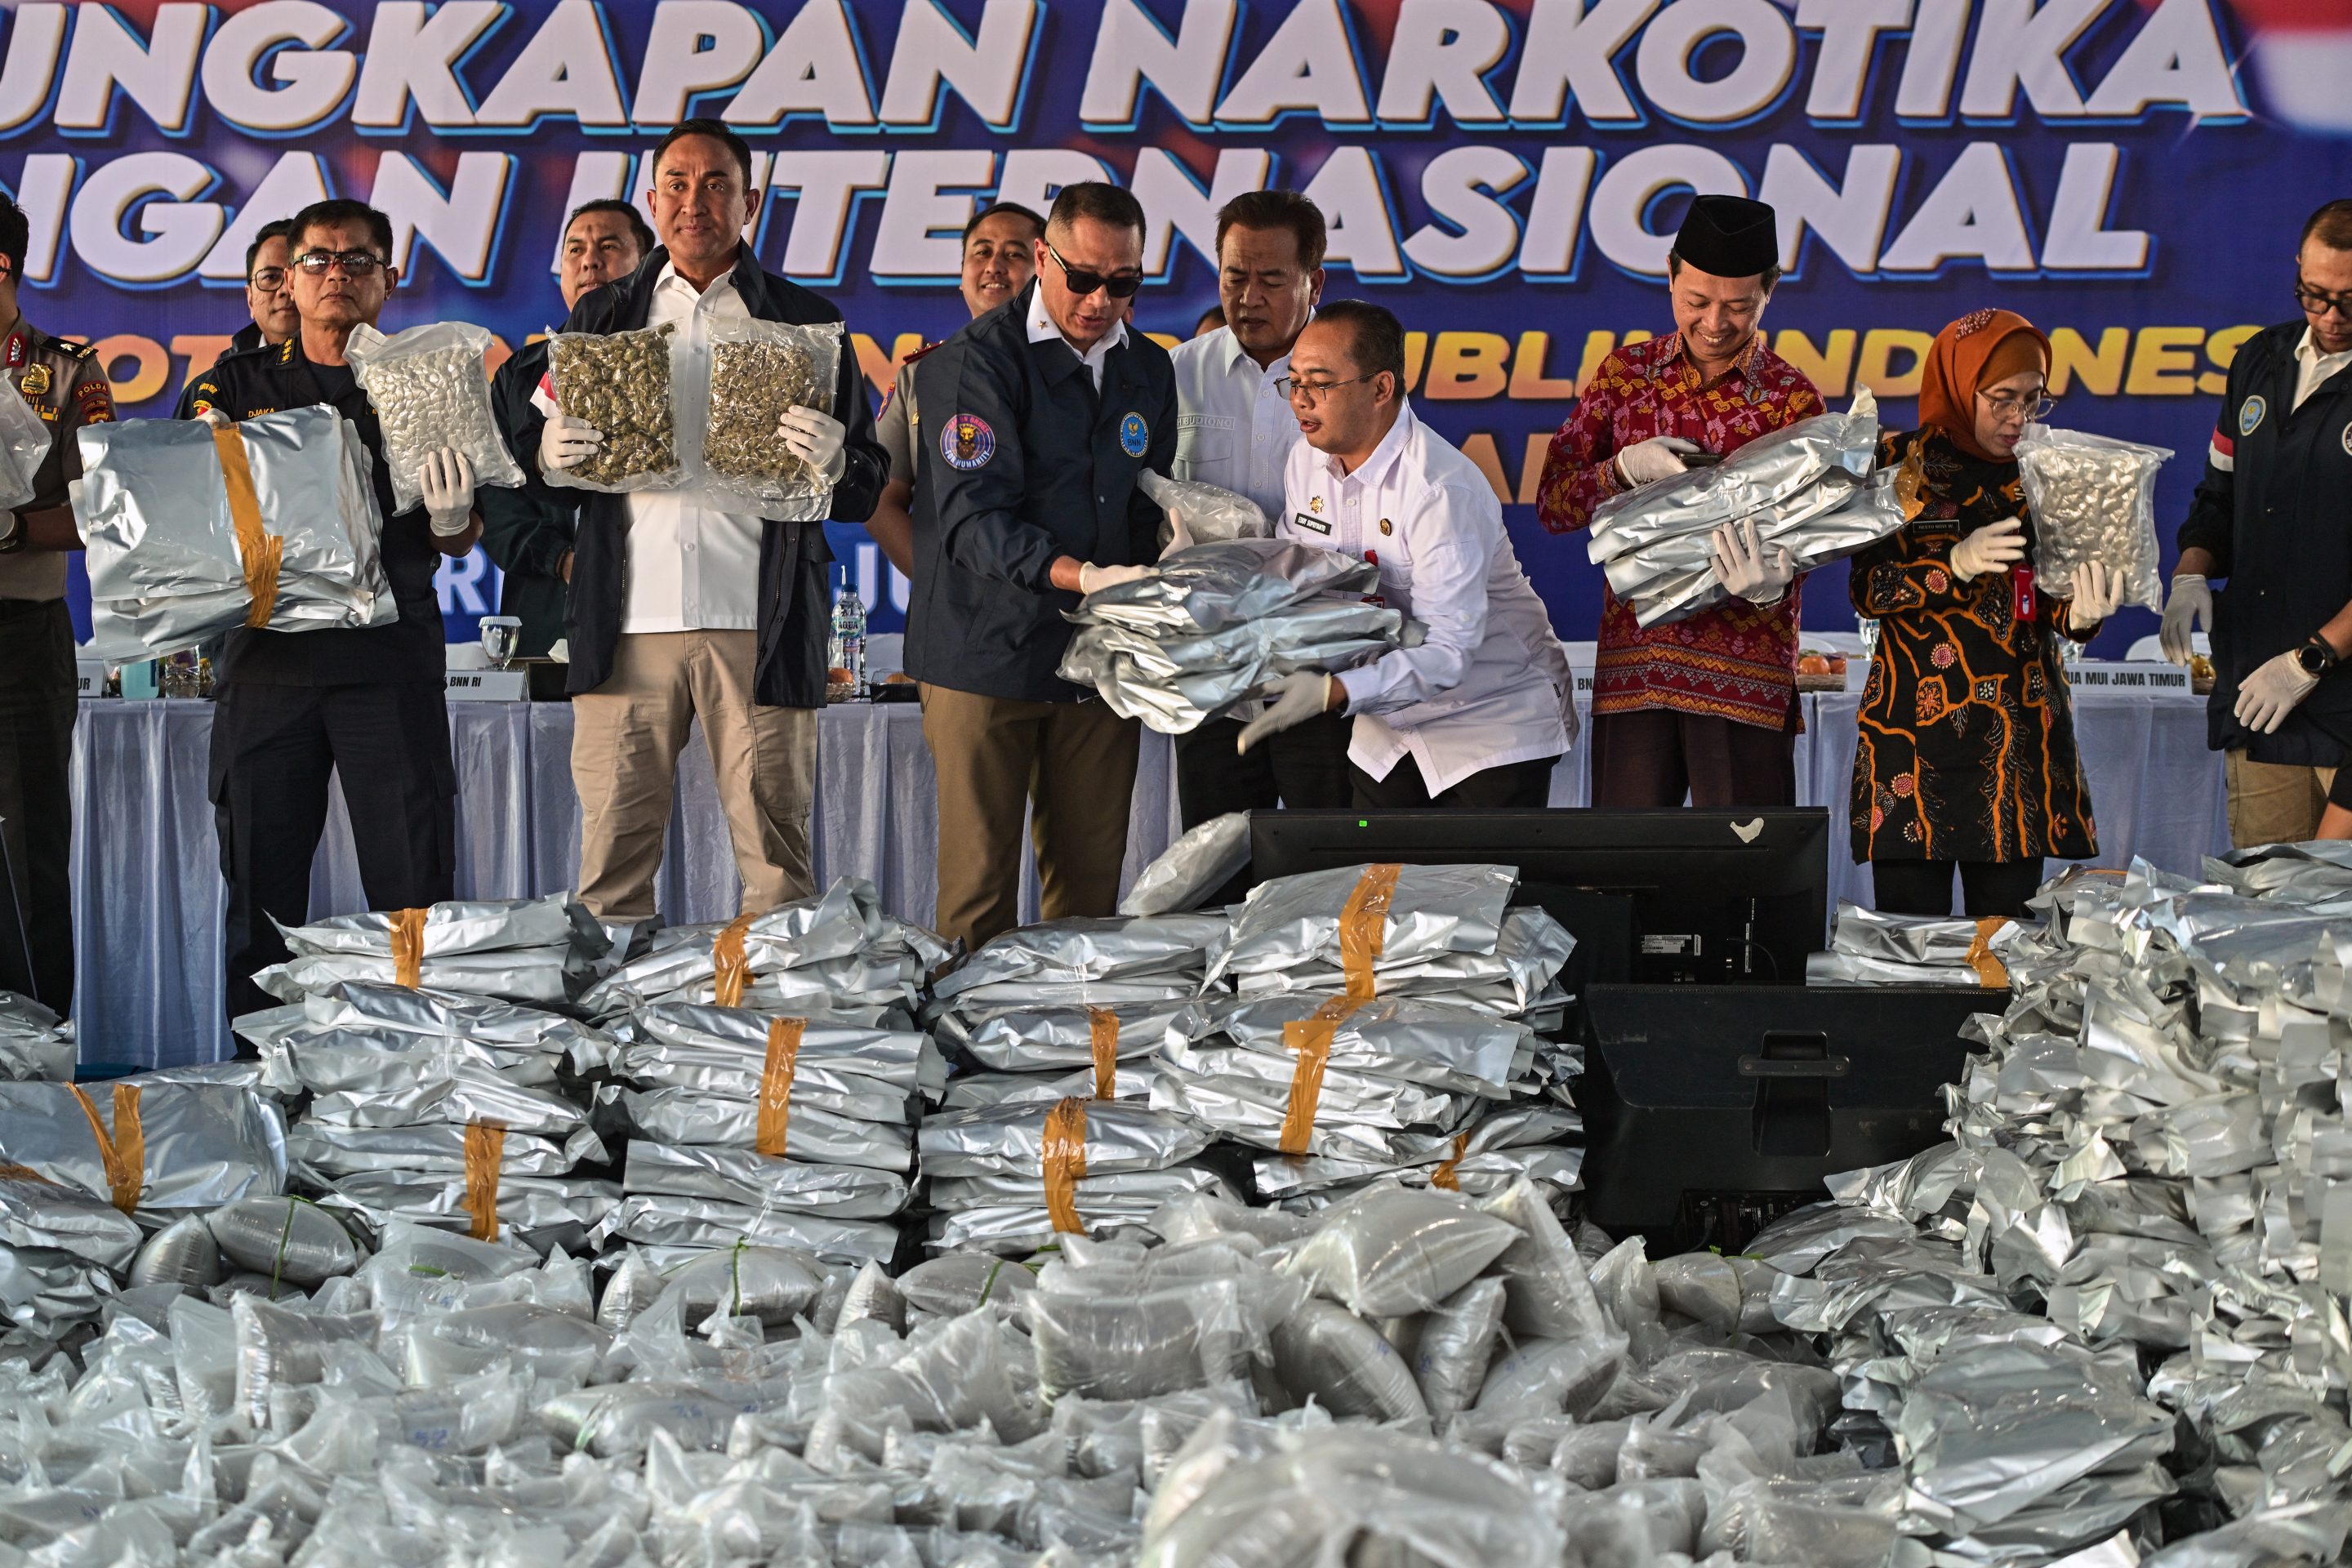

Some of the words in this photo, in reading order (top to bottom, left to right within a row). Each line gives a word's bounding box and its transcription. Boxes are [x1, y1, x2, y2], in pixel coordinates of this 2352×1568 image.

[1080, 0, 2247, 129] NARKOTIKA
[78, 382, 107, 398] POLDA
[248, 408, 274, 418] DJAKA
[1127, 439, 1142, 447] BNN
[956, 450, 990, 469] HUMANITY
[838, 621, 859, 630] AQUA
[449, 676, 470, 687] BNN
[471, 676, 482, 688] RI
[2086, 672, 2109, 685] MUI
[2112, 673, 2145, 686] JAWA
[2149, 674, 2186, 687] TIMUR
